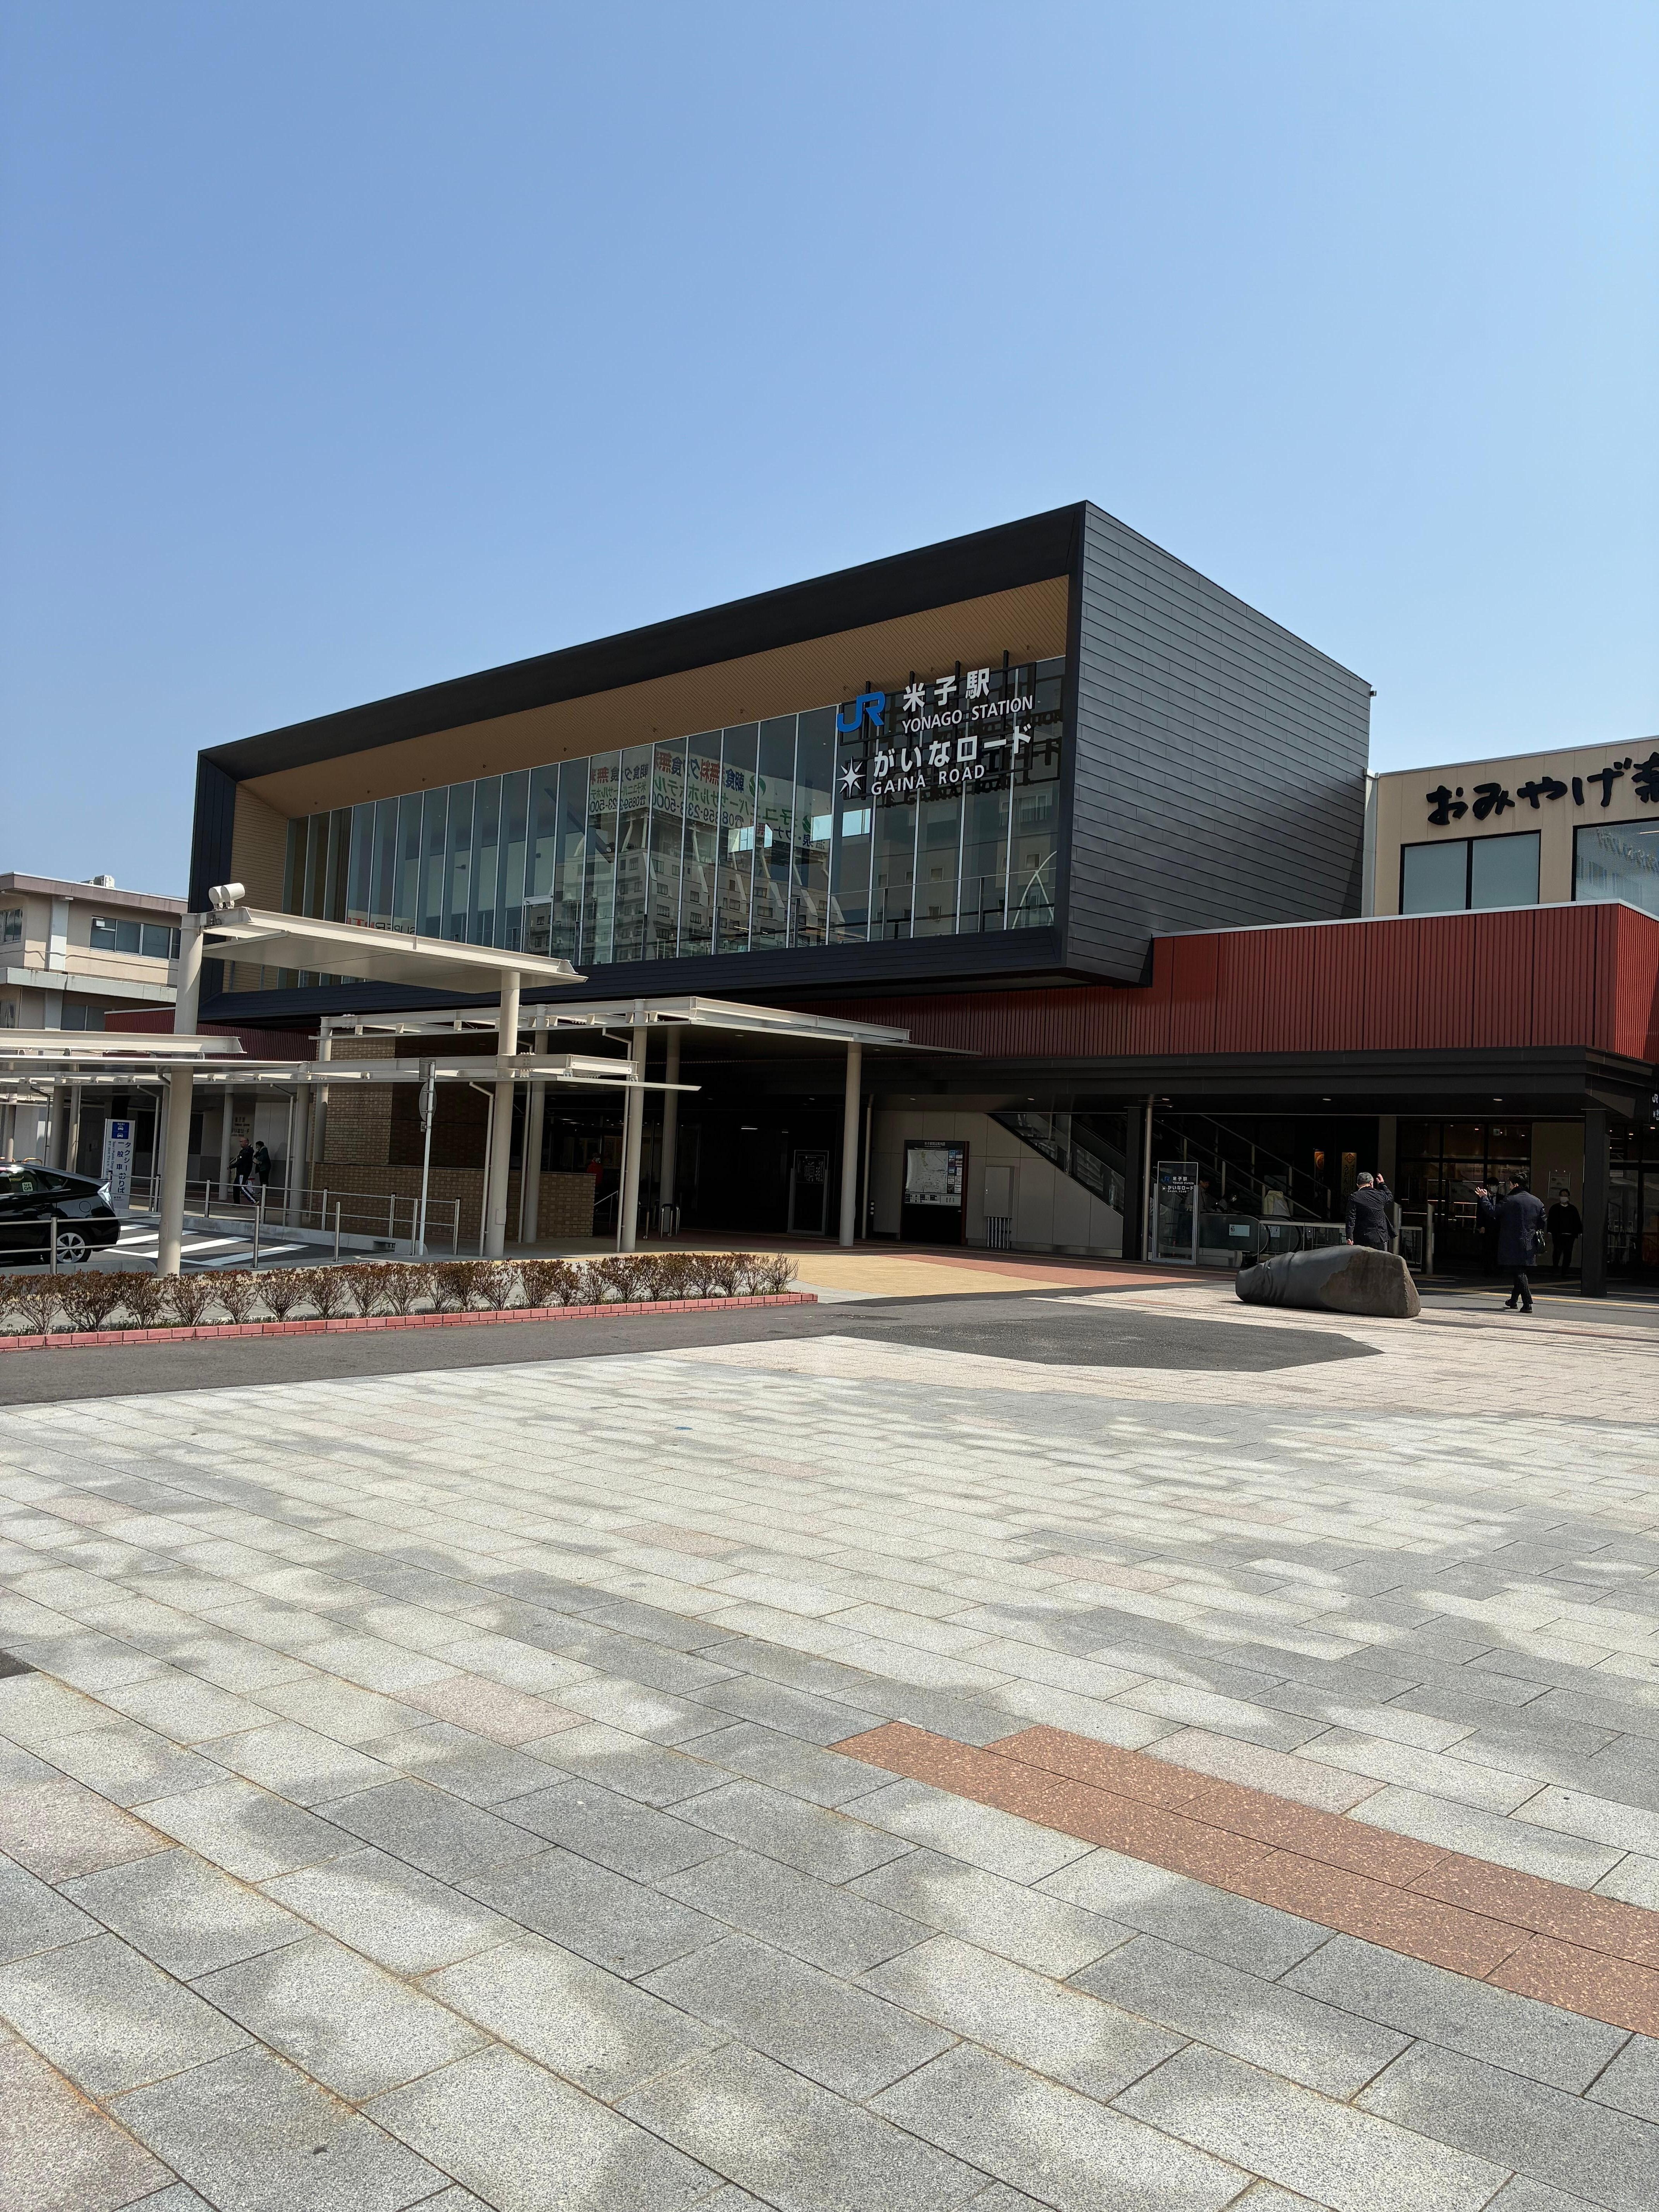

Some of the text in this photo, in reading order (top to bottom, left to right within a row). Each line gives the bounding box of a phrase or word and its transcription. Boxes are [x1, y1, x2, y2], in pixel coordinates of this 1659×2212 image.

[903, 668, 989, 712] 米子駅
[836, 691, 886, 732] JR
[902, 695, 1033, 734] YONAGO STATION
[873, 723, 1032, 778] がいなロード
[871, 764, 985, 795] GAINA ROAD
[116, 1142, 124, 1170] 一般車
